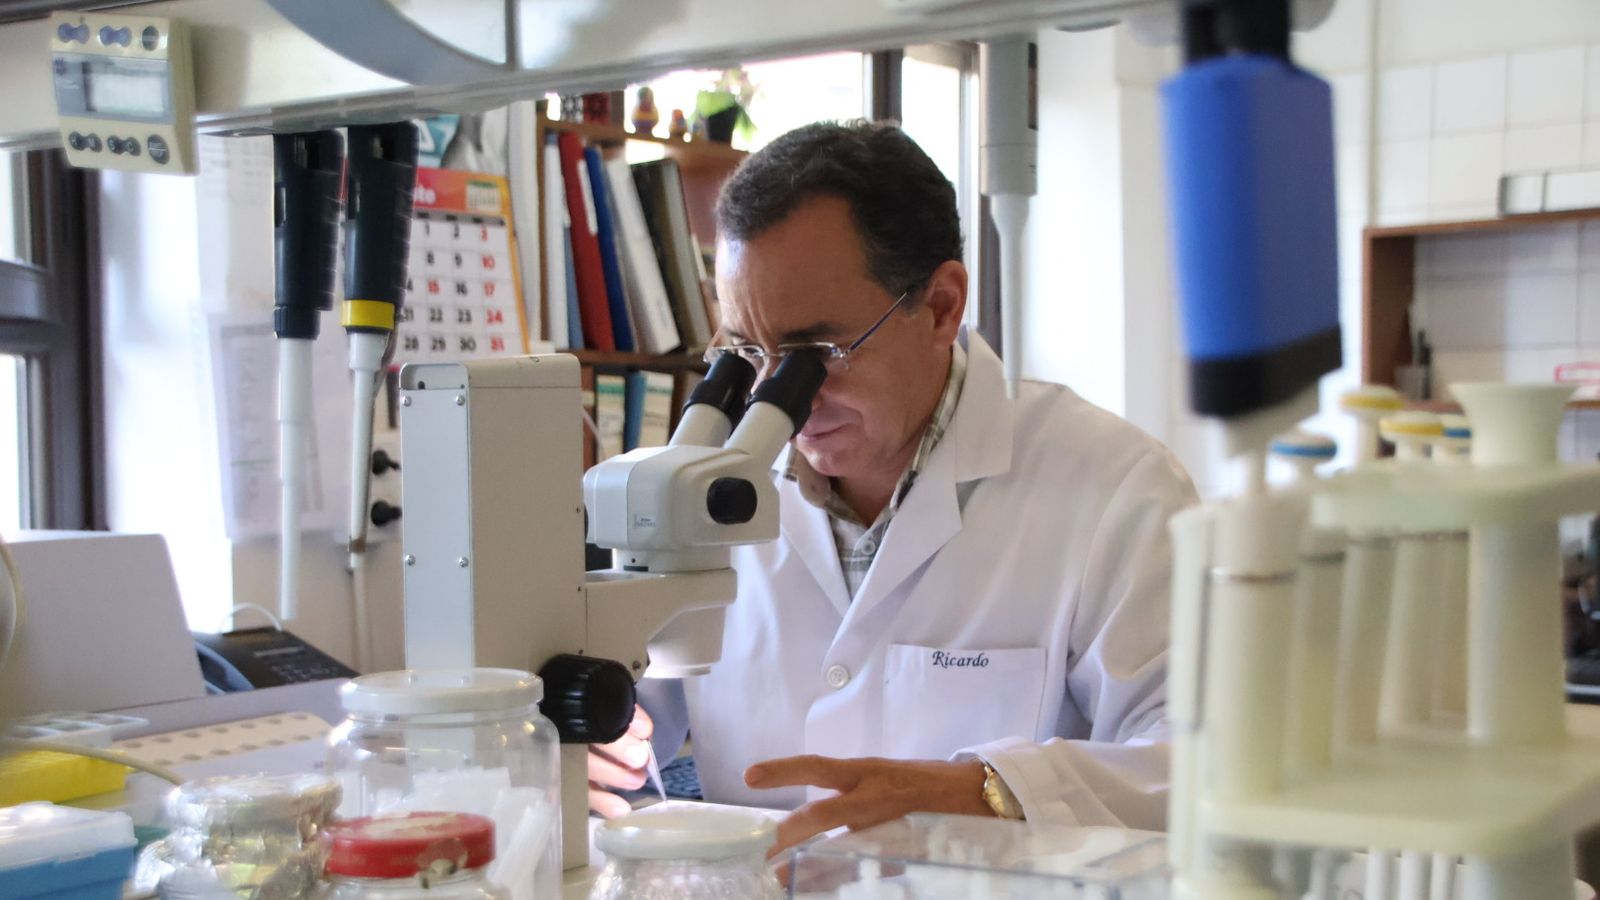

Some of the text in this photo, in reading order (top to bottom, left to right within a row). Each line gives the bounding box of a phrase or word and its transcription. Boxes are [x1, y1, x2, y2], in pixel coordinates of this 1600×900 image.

[453, 223, 460, 238] 2
[481, 224, 488, 241] 3
[427, 251, 495, 270] 8 9 10
[428, 279, 440, 294] 15
[456, 281, 468, 295] 16
[484, 281, 495, 296] 17
[430, 307, 443, 322] 22
[458, 309, 472, 323] 23
[487, 308, 503, 324] 24
[405, 336, 505, 351] 28 29 30 31
[932, 650, 990, 669] Ricardo
